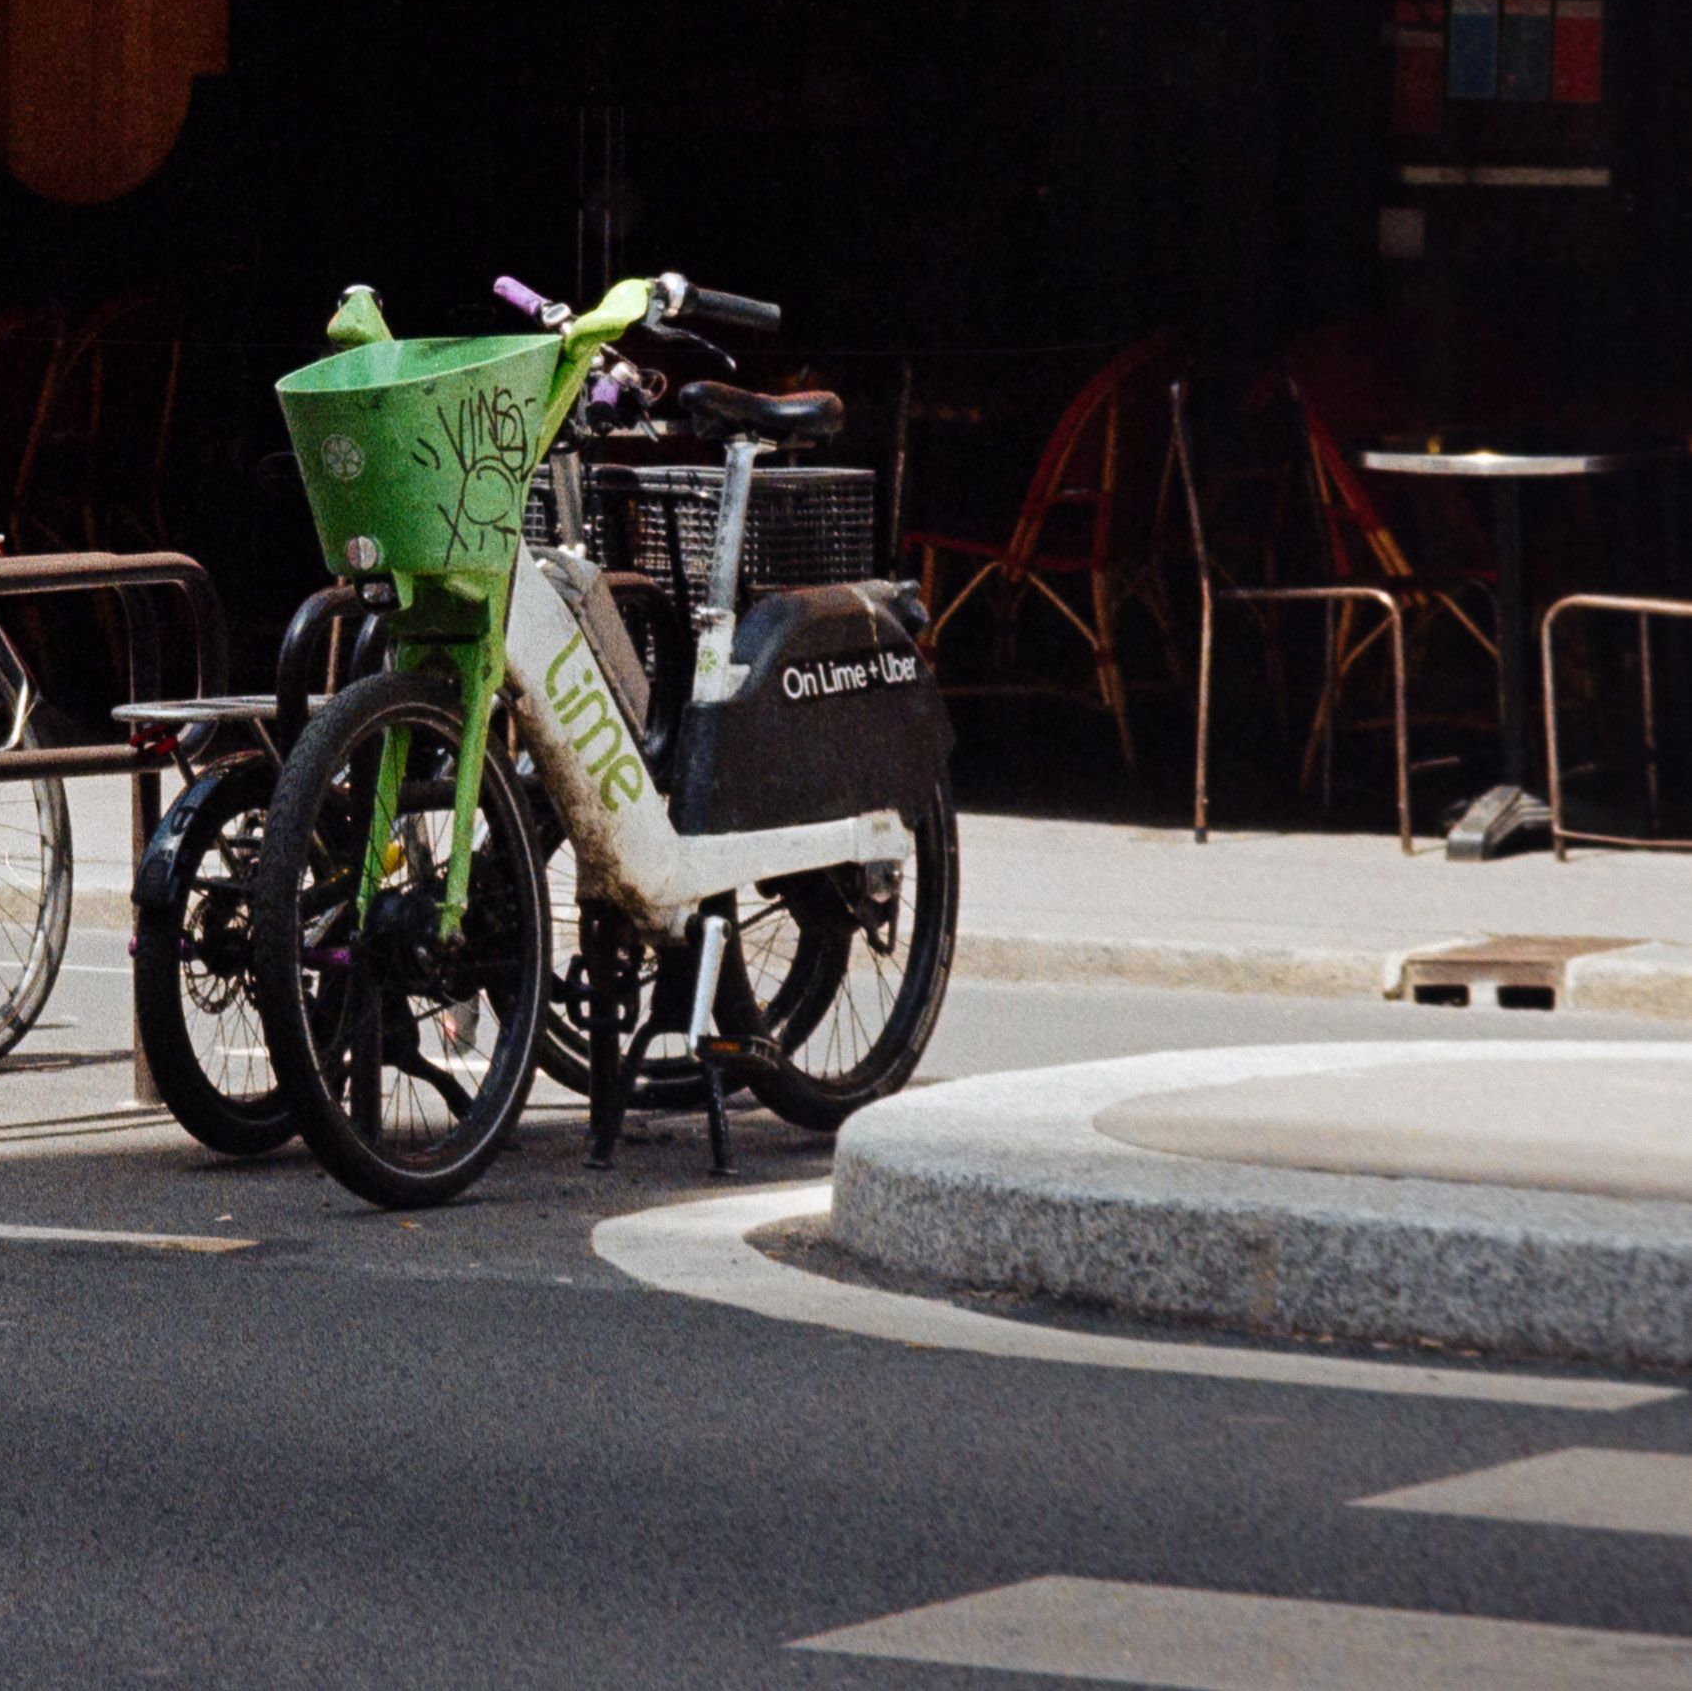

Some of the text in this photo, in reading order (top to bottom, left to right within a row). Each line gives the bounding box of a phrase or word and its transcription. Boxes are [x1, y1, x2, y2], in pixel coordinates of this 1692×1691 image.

[782, 666, 818, 700] On
[818, 660, 867, 694] Lime
[878, 652, 917, 684] Uber
